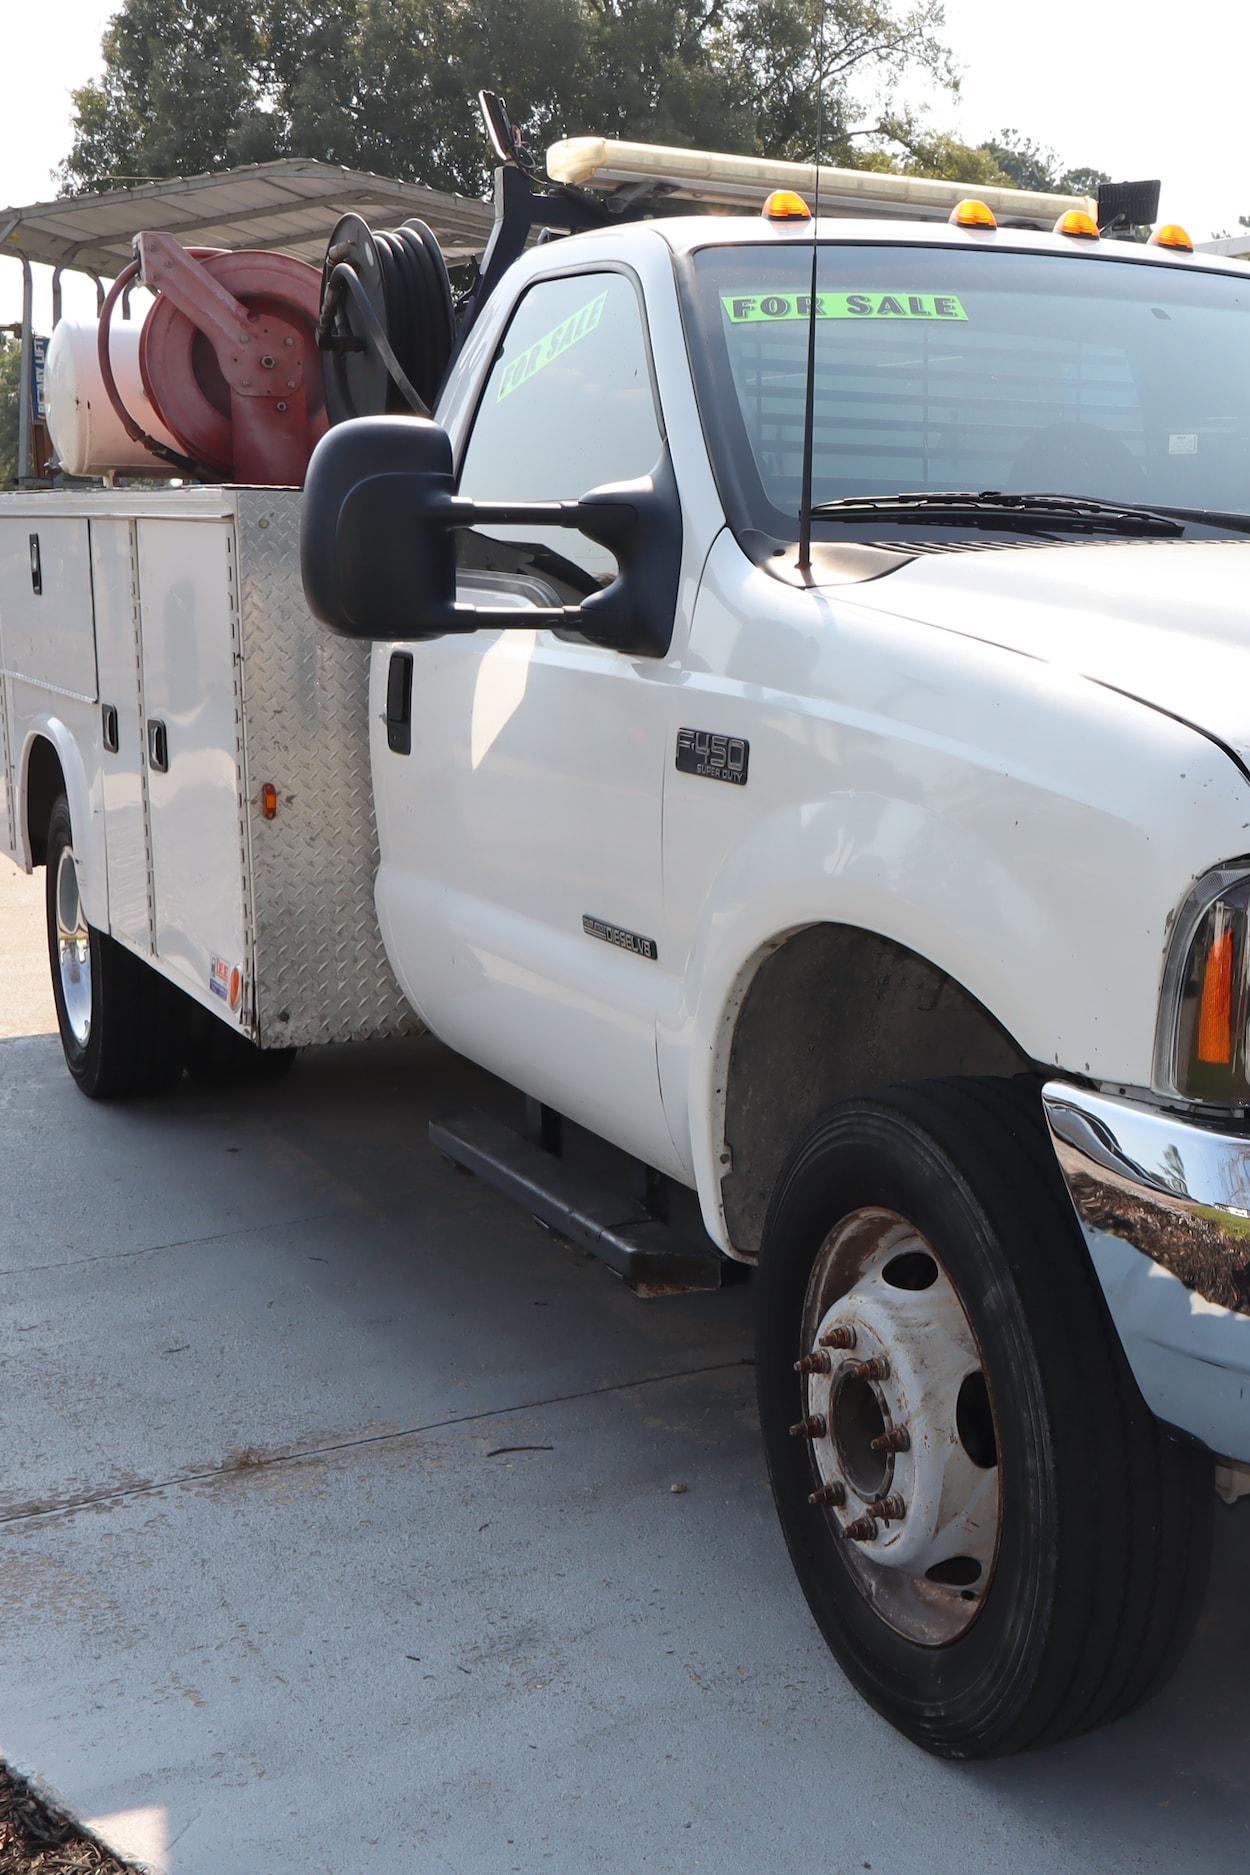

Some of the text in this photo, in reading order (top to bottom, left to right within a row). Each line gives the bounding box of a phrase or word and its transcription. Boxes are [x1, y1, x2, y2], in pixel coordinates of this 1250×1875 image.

[733, 295, 959, 319] FOR SALE
[34, 339, 45, 364] LIFT
[500, 296, 605, 395] FOR SALE
[676, 728, 745, 772] F-450
[696, 763, 744, 782] SUPER DUTY
